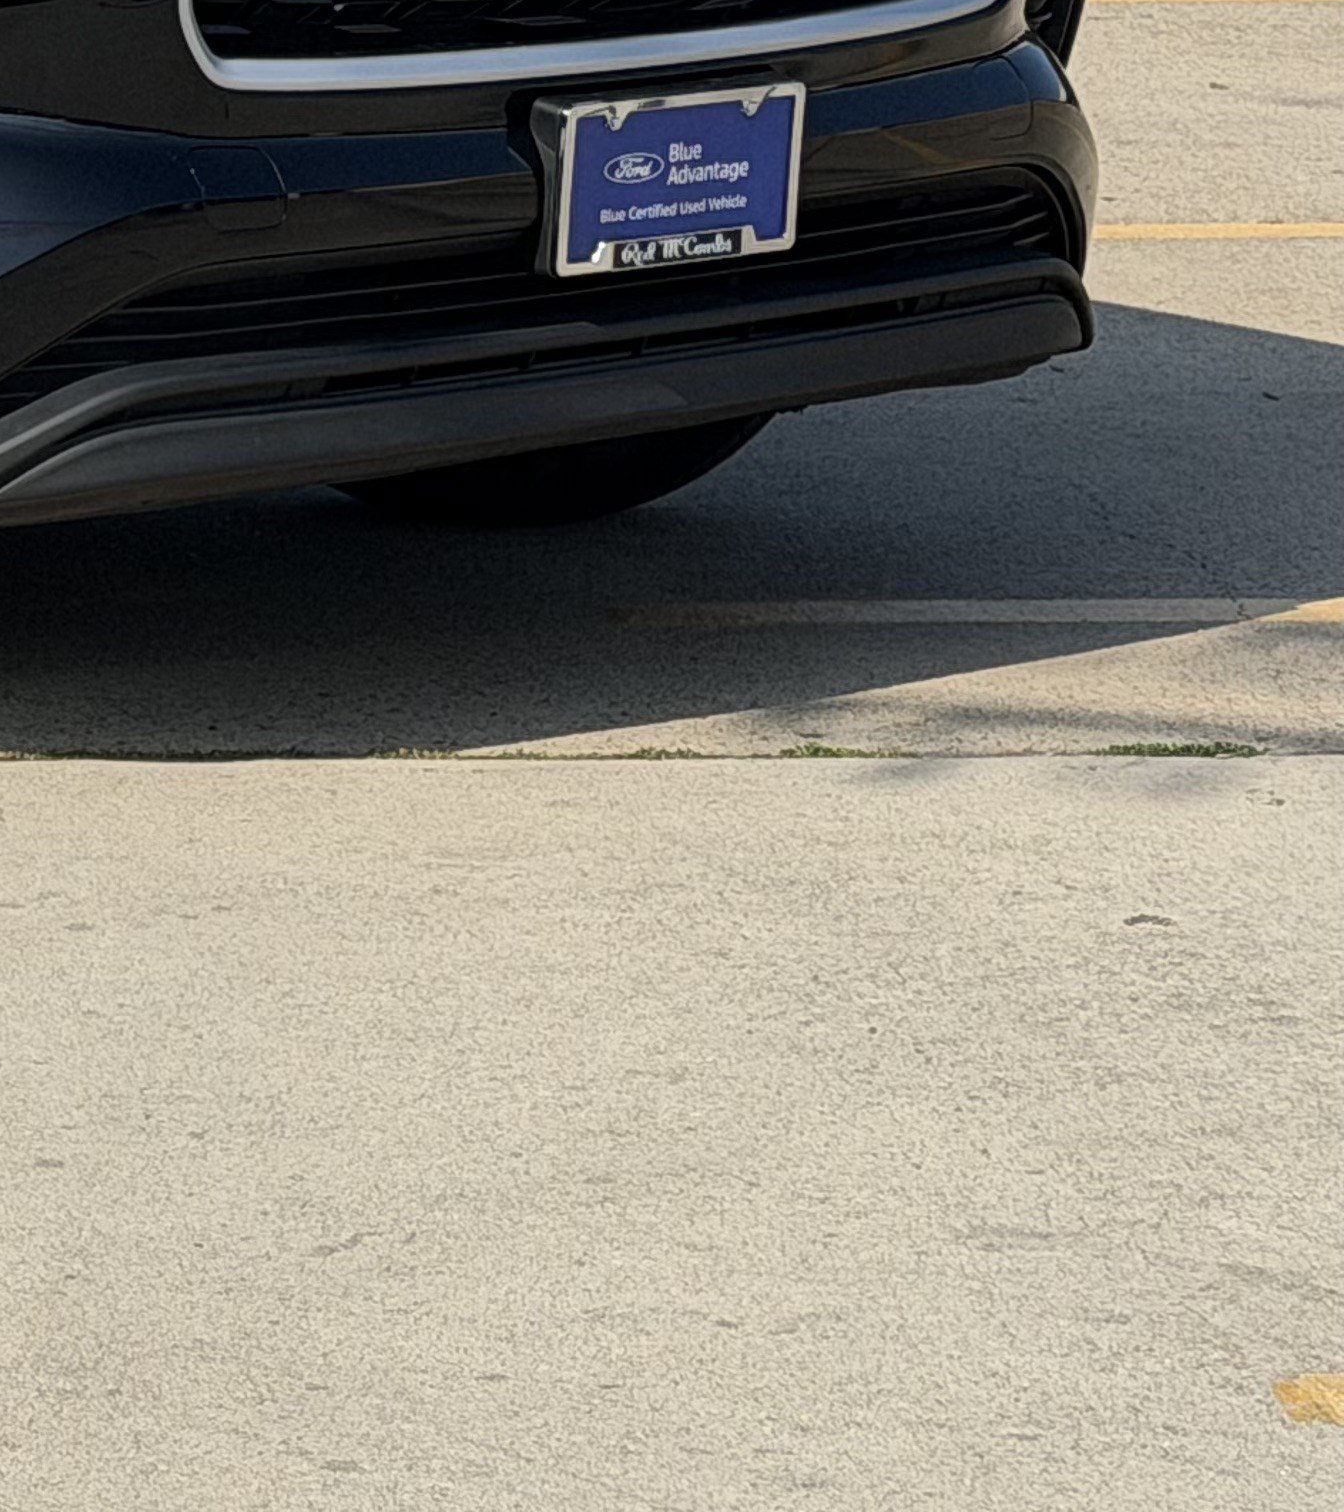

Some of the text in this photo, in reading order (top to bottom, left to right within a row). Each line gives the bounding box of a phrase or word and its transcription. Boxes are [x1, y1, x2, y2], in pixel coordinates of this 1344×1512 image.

[668, 141, 703, 163] Blue
[614, 157, 654, 179] Ford
[666, 160, 750, 185] Advantage
[599, 194, 748, 224] Blue Certified Used Vehicle
